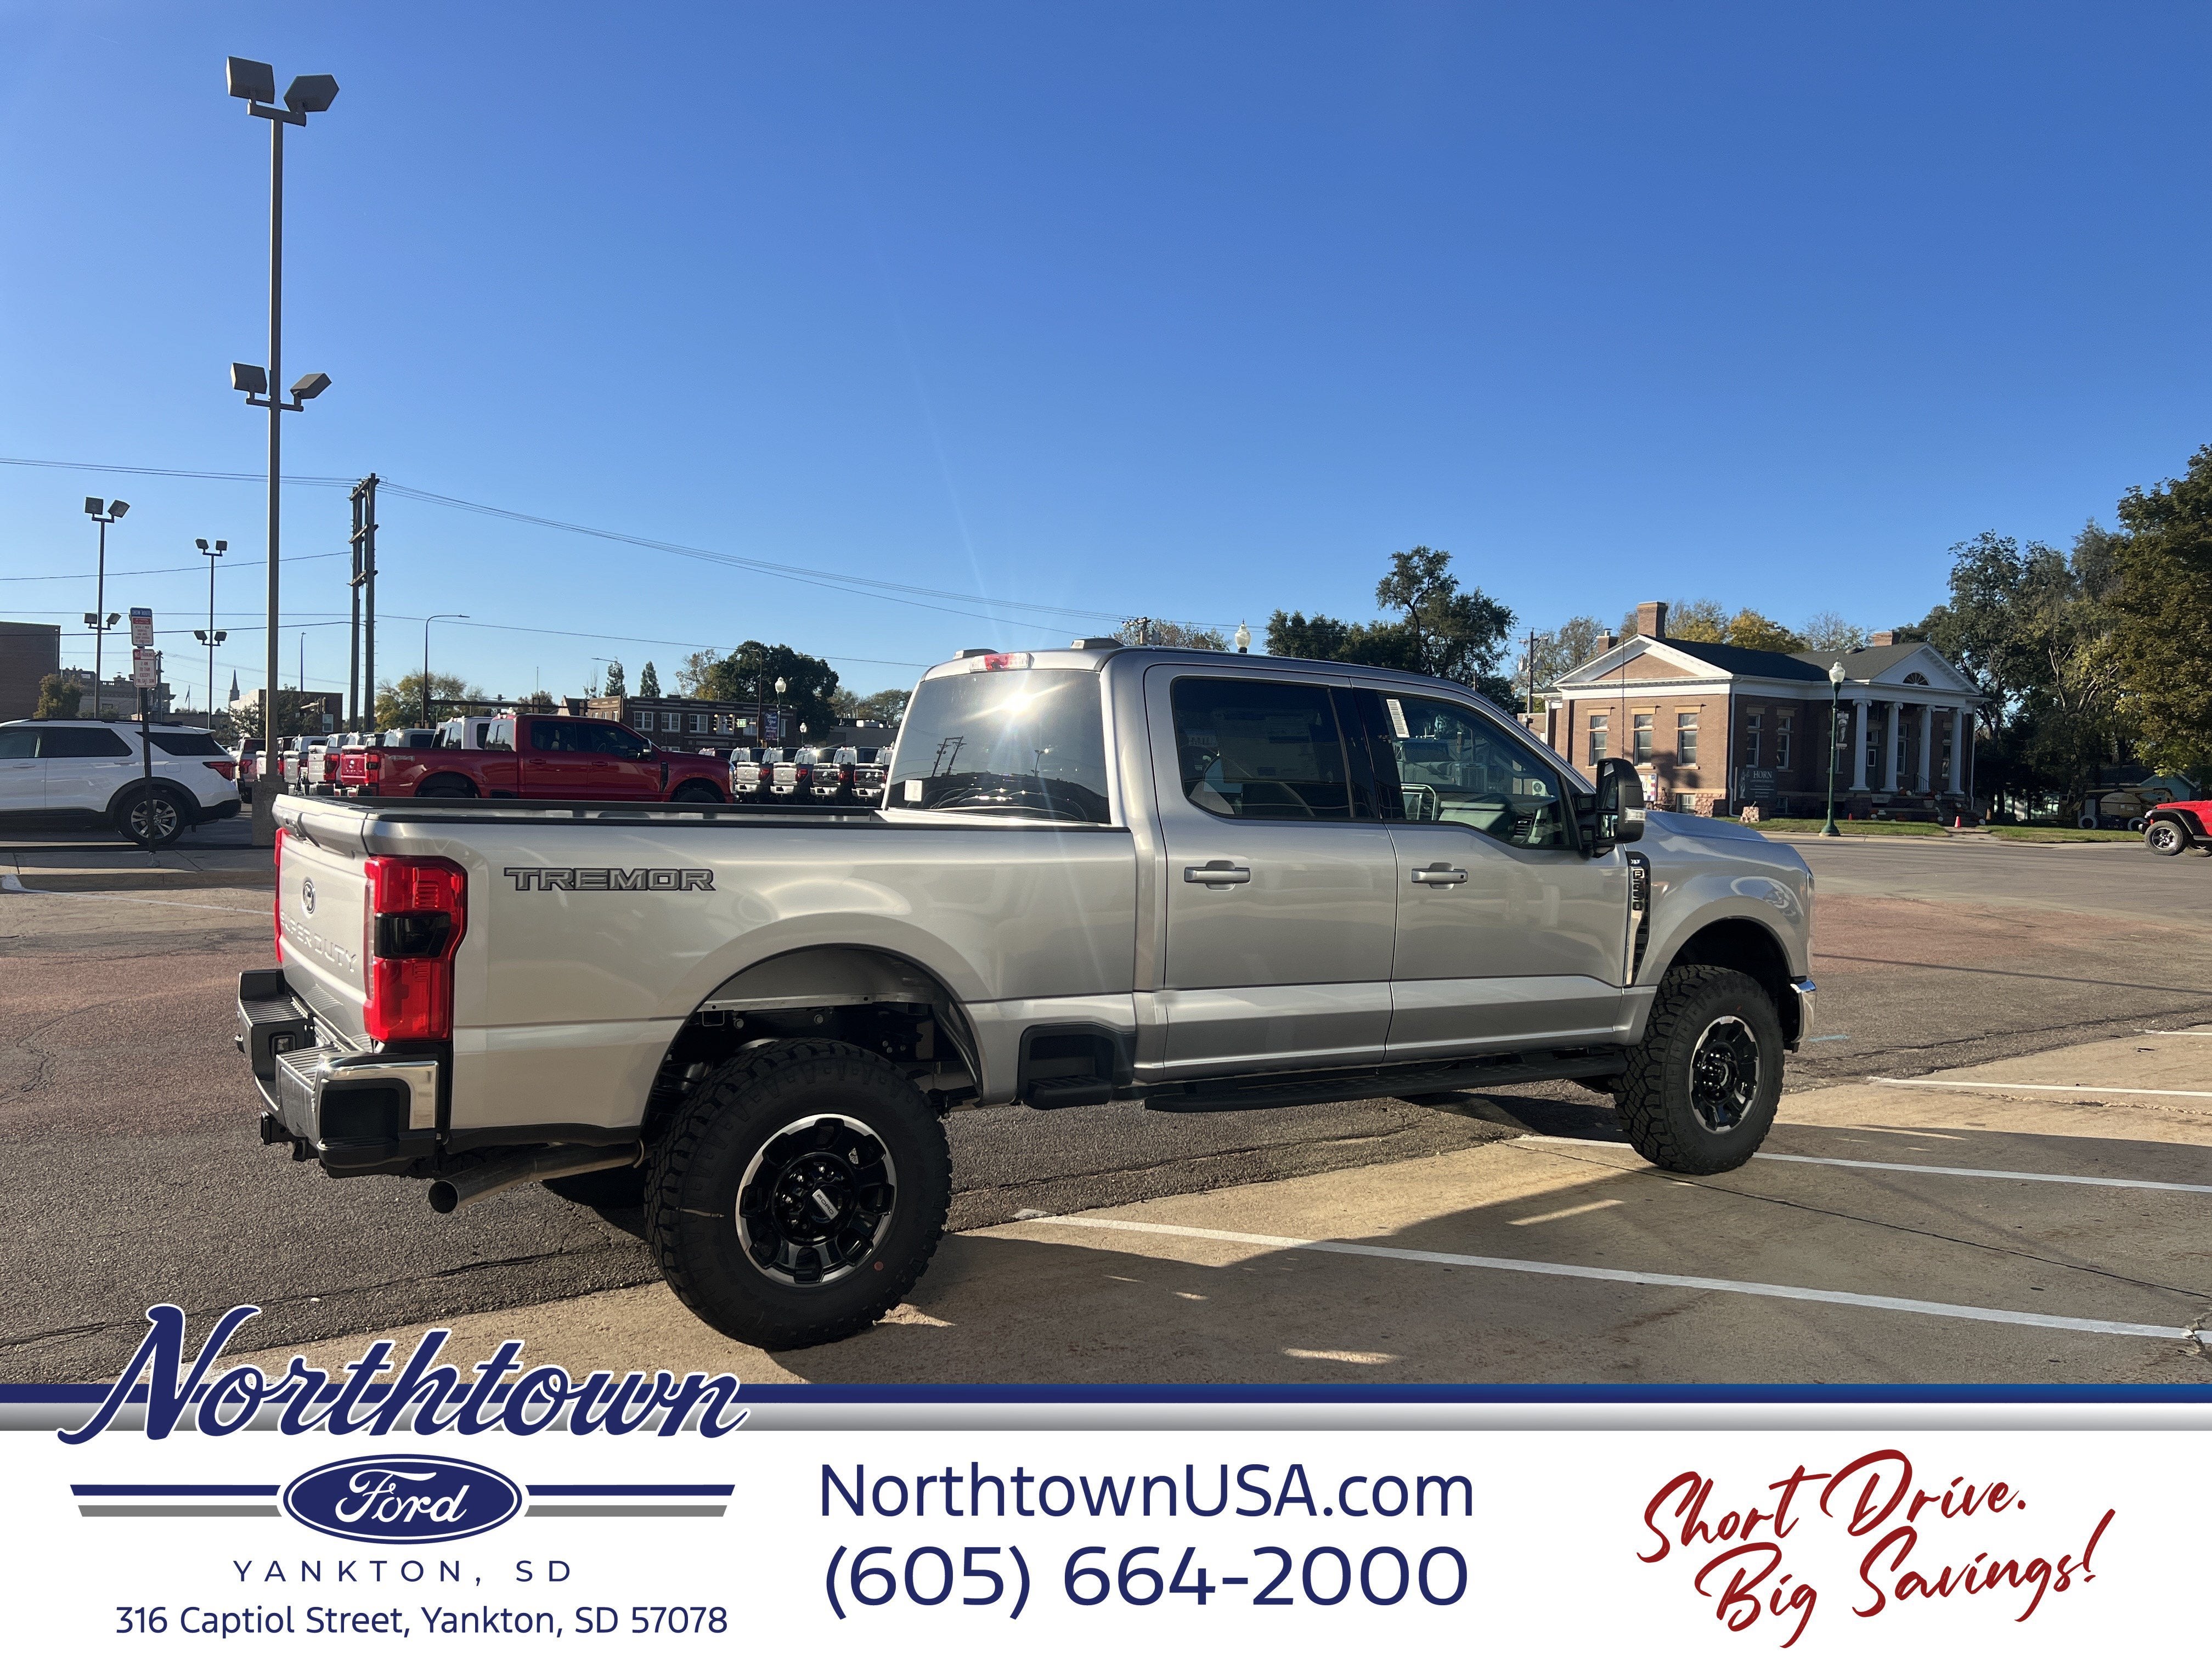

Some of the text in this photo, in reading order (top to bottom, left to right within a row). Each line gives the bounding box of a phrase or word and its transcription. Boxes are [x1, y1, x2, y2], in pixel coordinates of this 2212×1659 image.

[1753, 770, 1773, 778] HORN
[504, 867, 716, 891] TREMOR
[314, 933, 357, 973] DUTY
[817, 1194, 834, 1215] FORD
